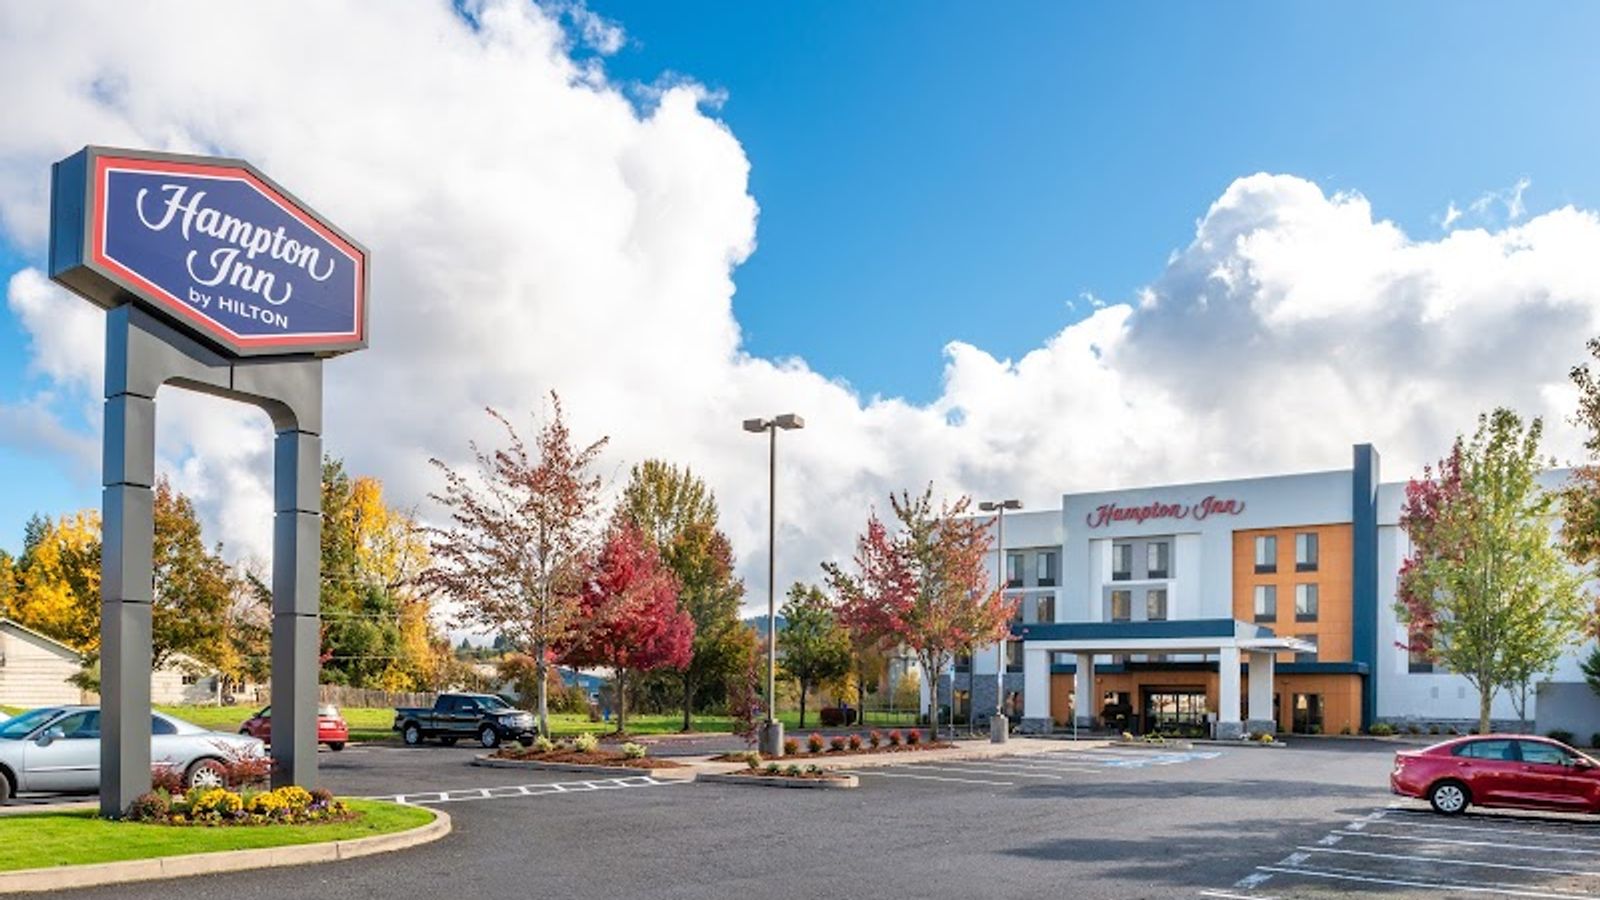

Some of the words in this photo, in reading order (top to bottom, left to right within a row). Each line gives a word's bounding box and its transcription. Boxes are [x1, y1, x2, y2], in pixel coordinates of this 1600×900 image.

[136, 184, 335, 281] Hampton
[186, 248, 292, 305] Inn
[189, 286, 212, 308] by
[219, 296, 288, 329] HILTON
[1086, 502, 1189, 529] Hampton
[1192, 495, 1246, 521] Inn
